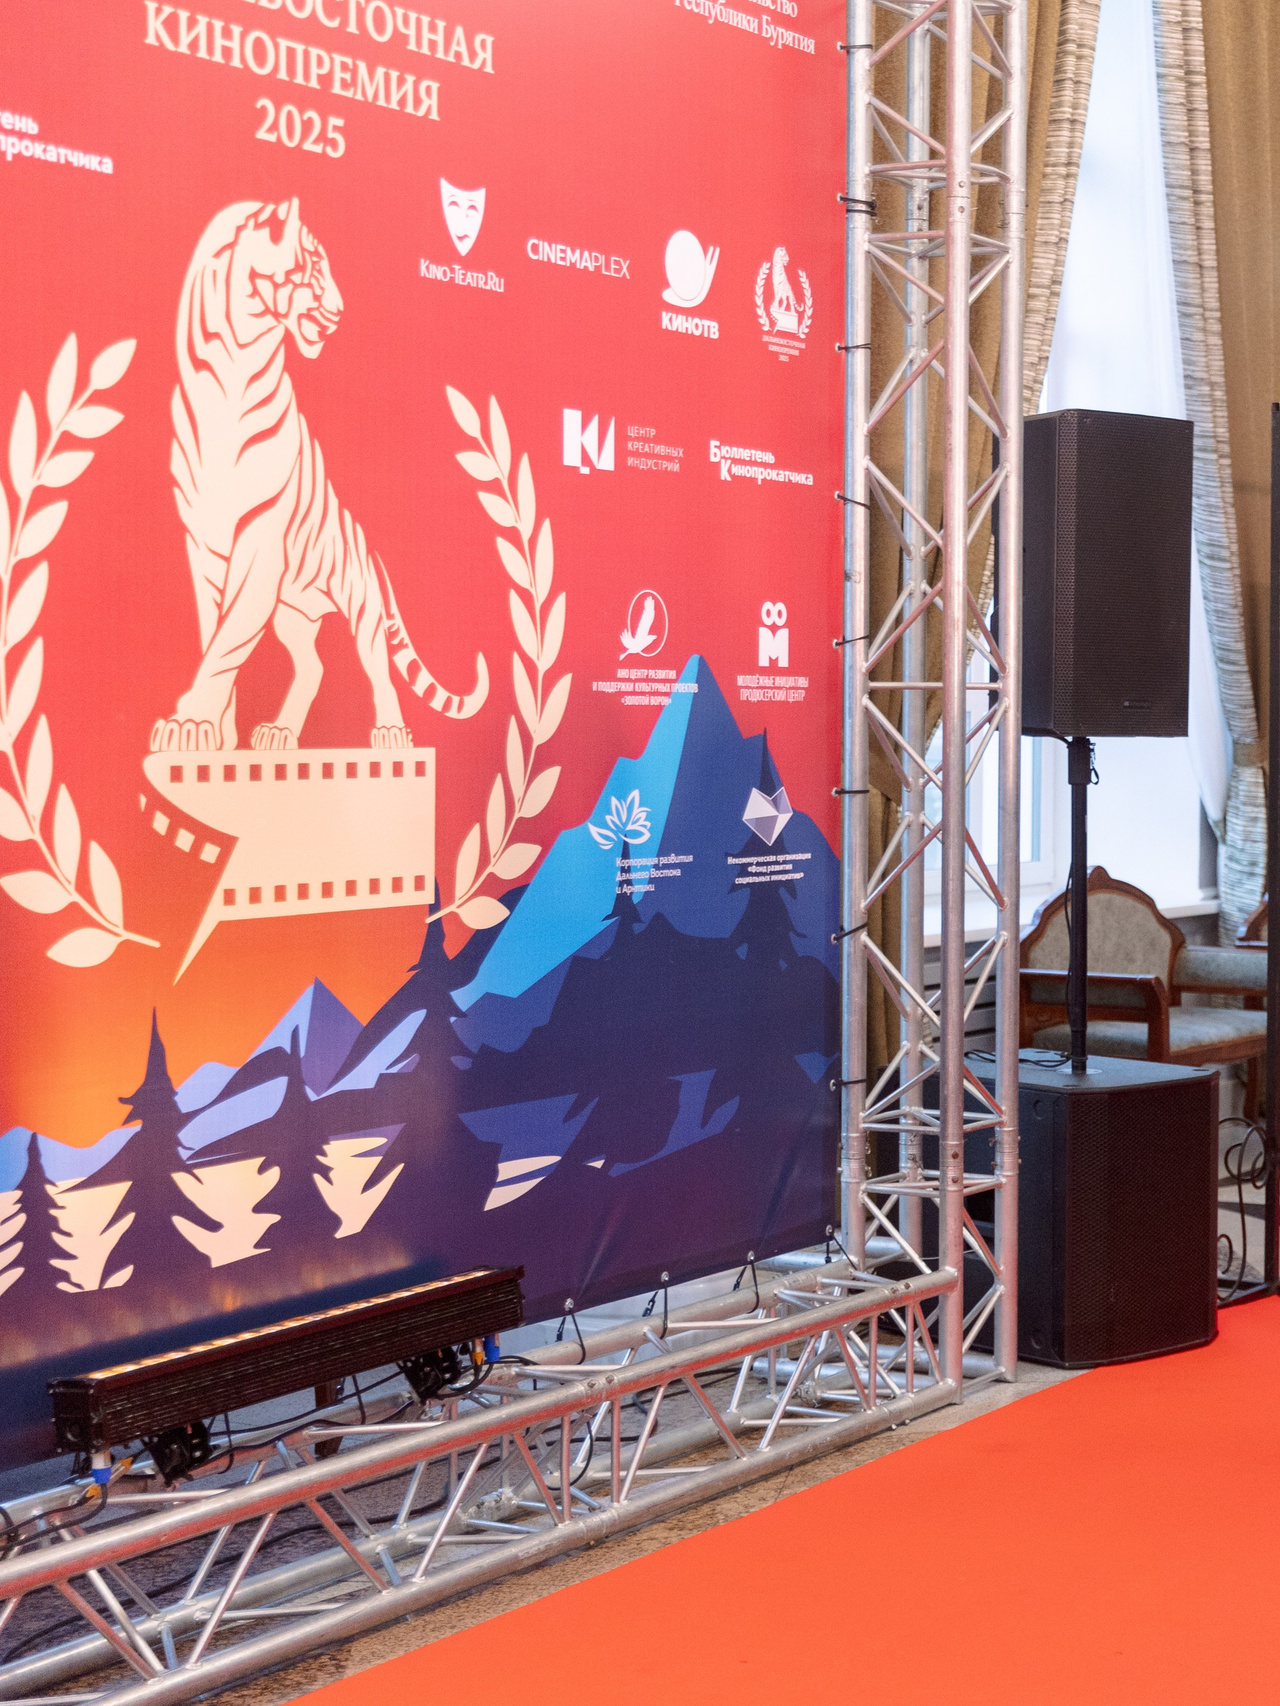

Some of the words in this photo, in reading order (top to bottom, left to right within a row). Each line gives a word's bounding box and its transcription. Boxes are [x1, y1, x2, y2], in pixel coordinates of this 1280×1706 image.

[761, 14, 815, 54] Бурятия
[143, 0, 440, 121] КИНОПРЕМИЯ
[0, 111, 39, 135] ень
[255, 98, 346, 158] 2025
[526, 238, 631, 280] CINEMAPLEX
[661, 311, 719, 340] КИНОТВ
[627, 426, 656, 439] ЦЕНТР
[627, 441, 684, 457] КРЕАТИВНЫХ
[709, 440, 775, 464] Бюллетень
[627, 456, 680, 472] ИНДУСТРИЙ
[720, 459, 814, 485] Кинопрокатчика
[616, 668, 629, 679] АНО
[629, 669, 648, 680] ЦЕНТР
[648, 669, 677, 680] РАЗВИТИЯ
[592, 681, 598, 692] И
[598, 682, 634, 693] ПОДДЕРЖКИ
[634, 682, 671, 693] КУЛЬТУРНЫХ
[671, 683, 699, 693] ПРОЕКТОВ
[740, 688, 787, 703] ПРОДЮСЕРСКИЙ
[787, 689, 806, 703] ЦЕНТР
[616, 857, 659, 870] Корпорация
[659, 853, 694, 867] развития
[615, 870, 649, 882] Дальнего
[650, 868, 681, 879] Востока
[622, 884, 655, 896] Арктики
